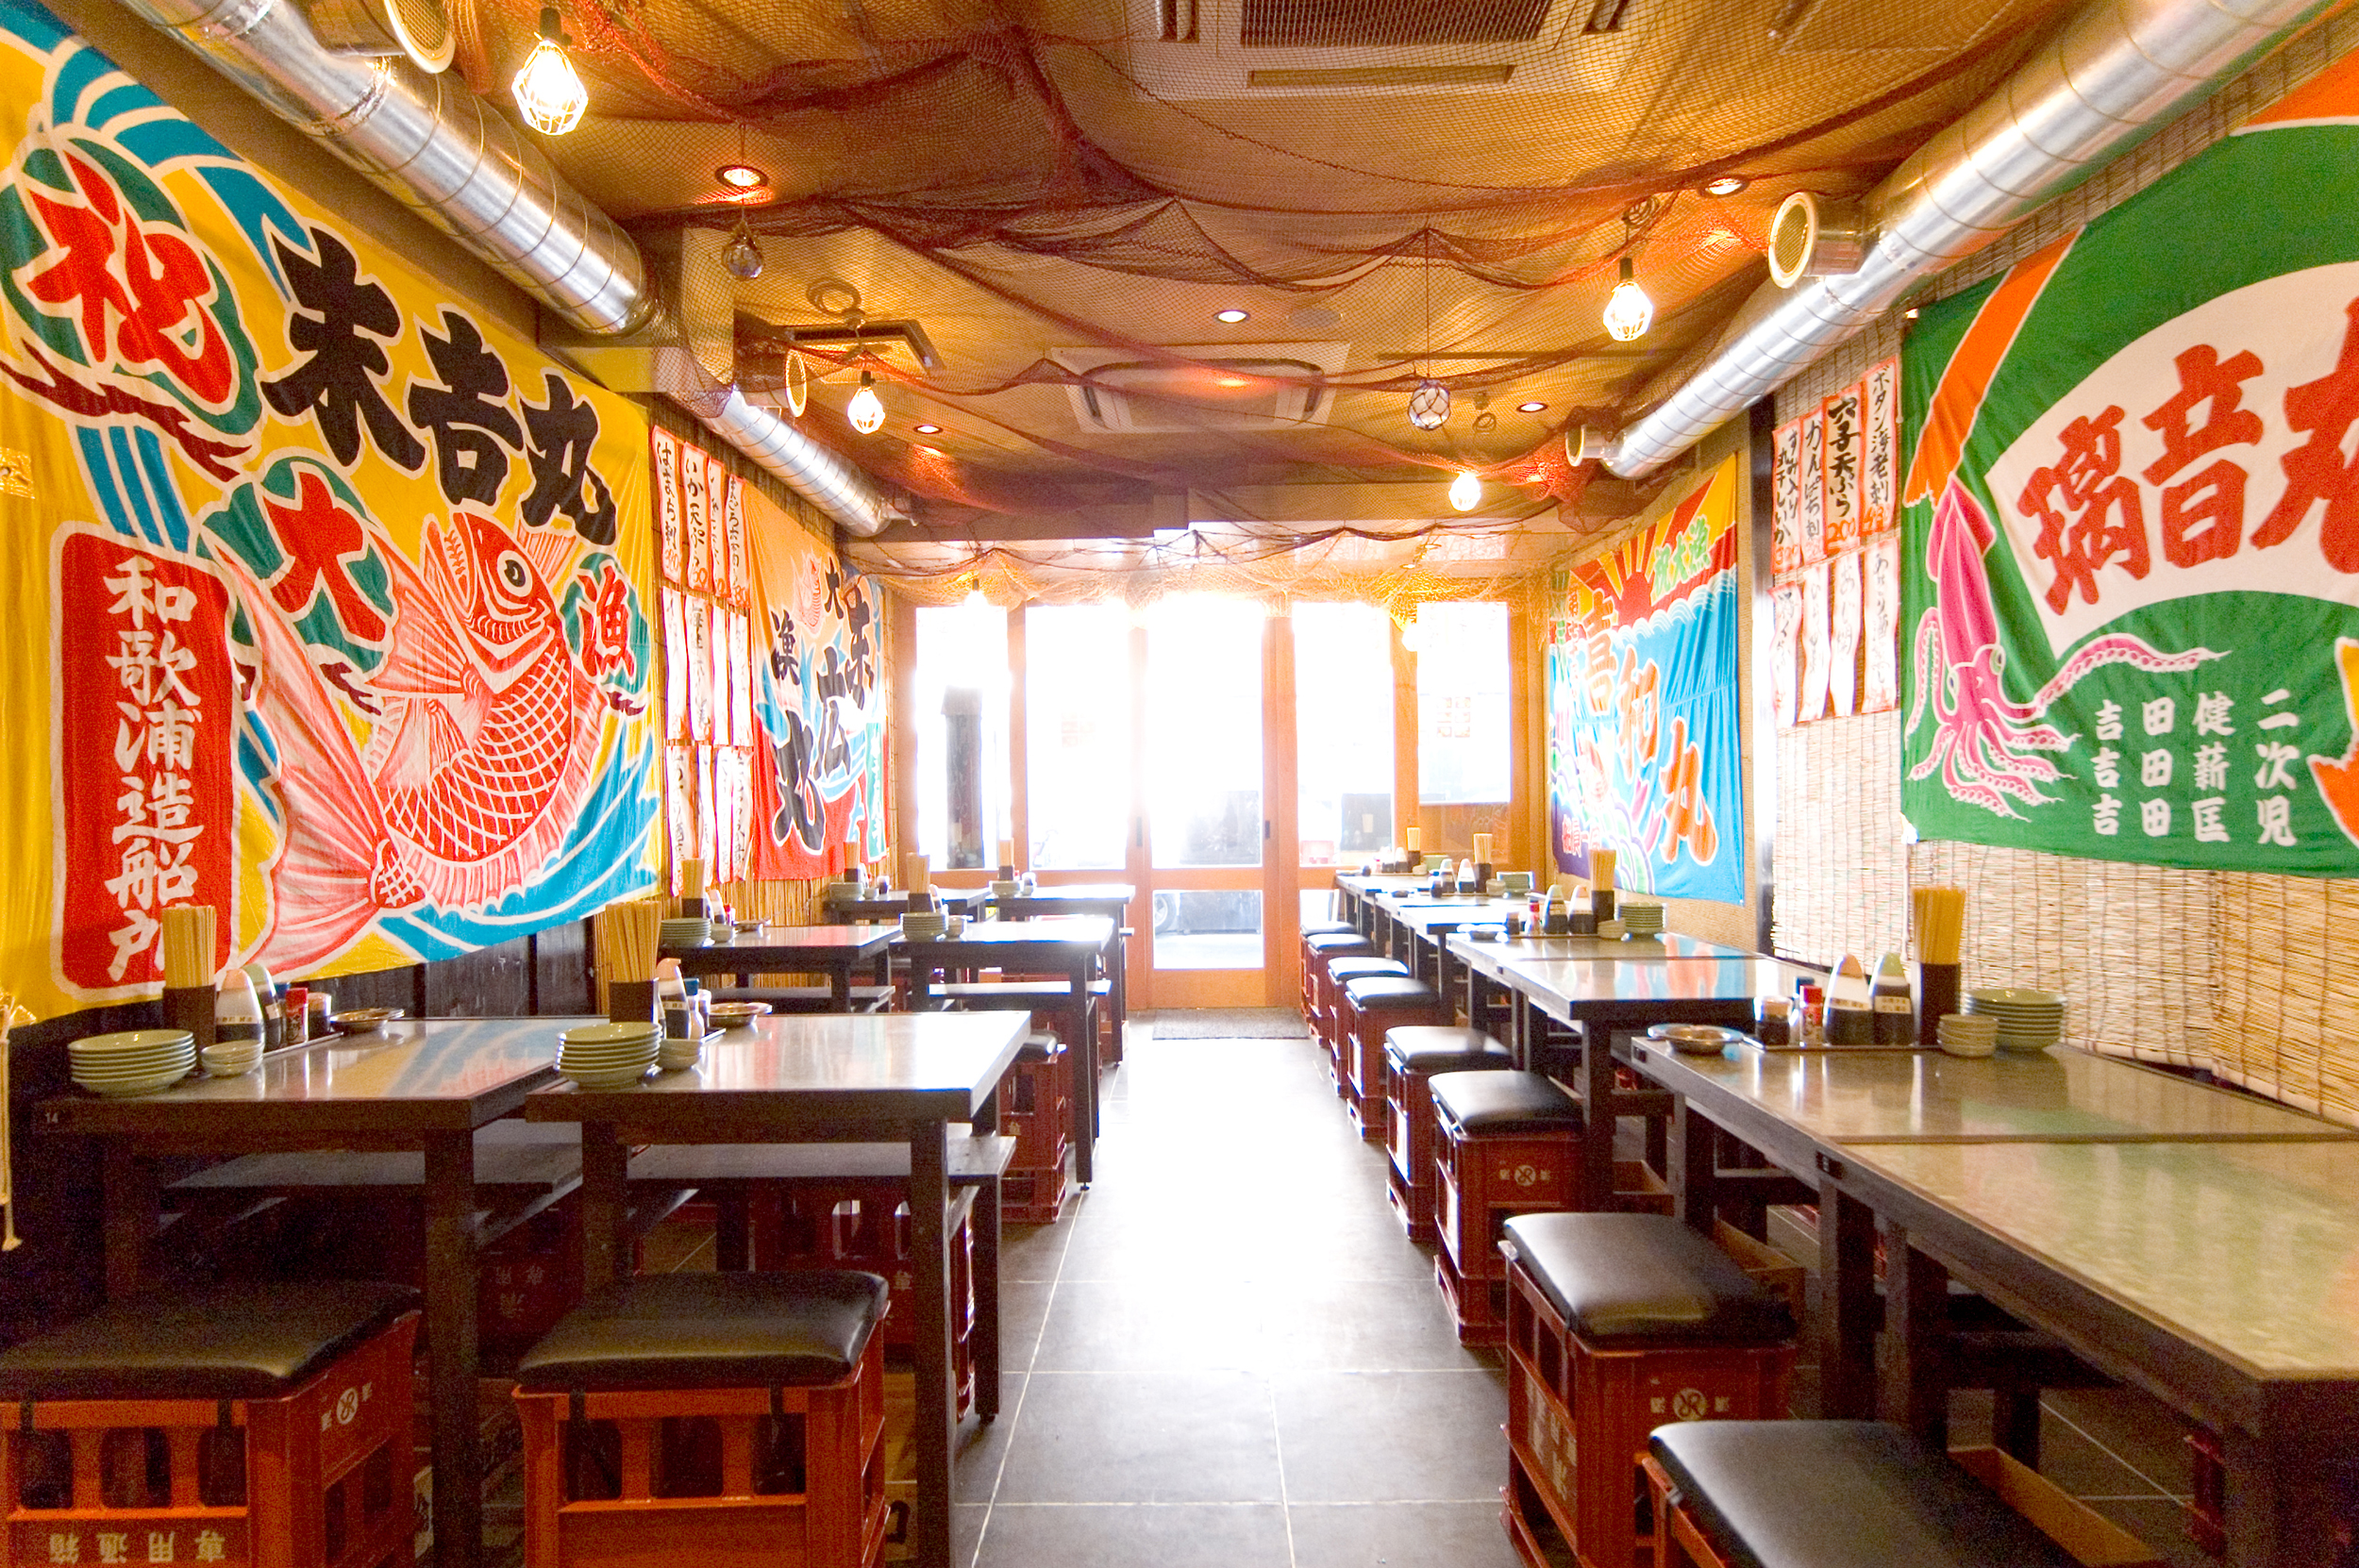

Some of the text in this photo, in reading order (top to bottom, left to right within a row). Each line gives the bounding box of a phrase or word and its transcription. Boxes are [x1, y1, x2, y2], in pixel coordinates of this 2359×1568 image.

[1828, 396, 1860, 518] 穴子天ぷら
[262, 471, 389, 643] 大
[826, 557, 845, 620] 大
[580, 562, 638, 683] 漁
[771, 609, 800, 686] 漁
[2095, 689, 2300, 741] 吉田健二
[2091, 793, 2298, 847] 吉田匡児
